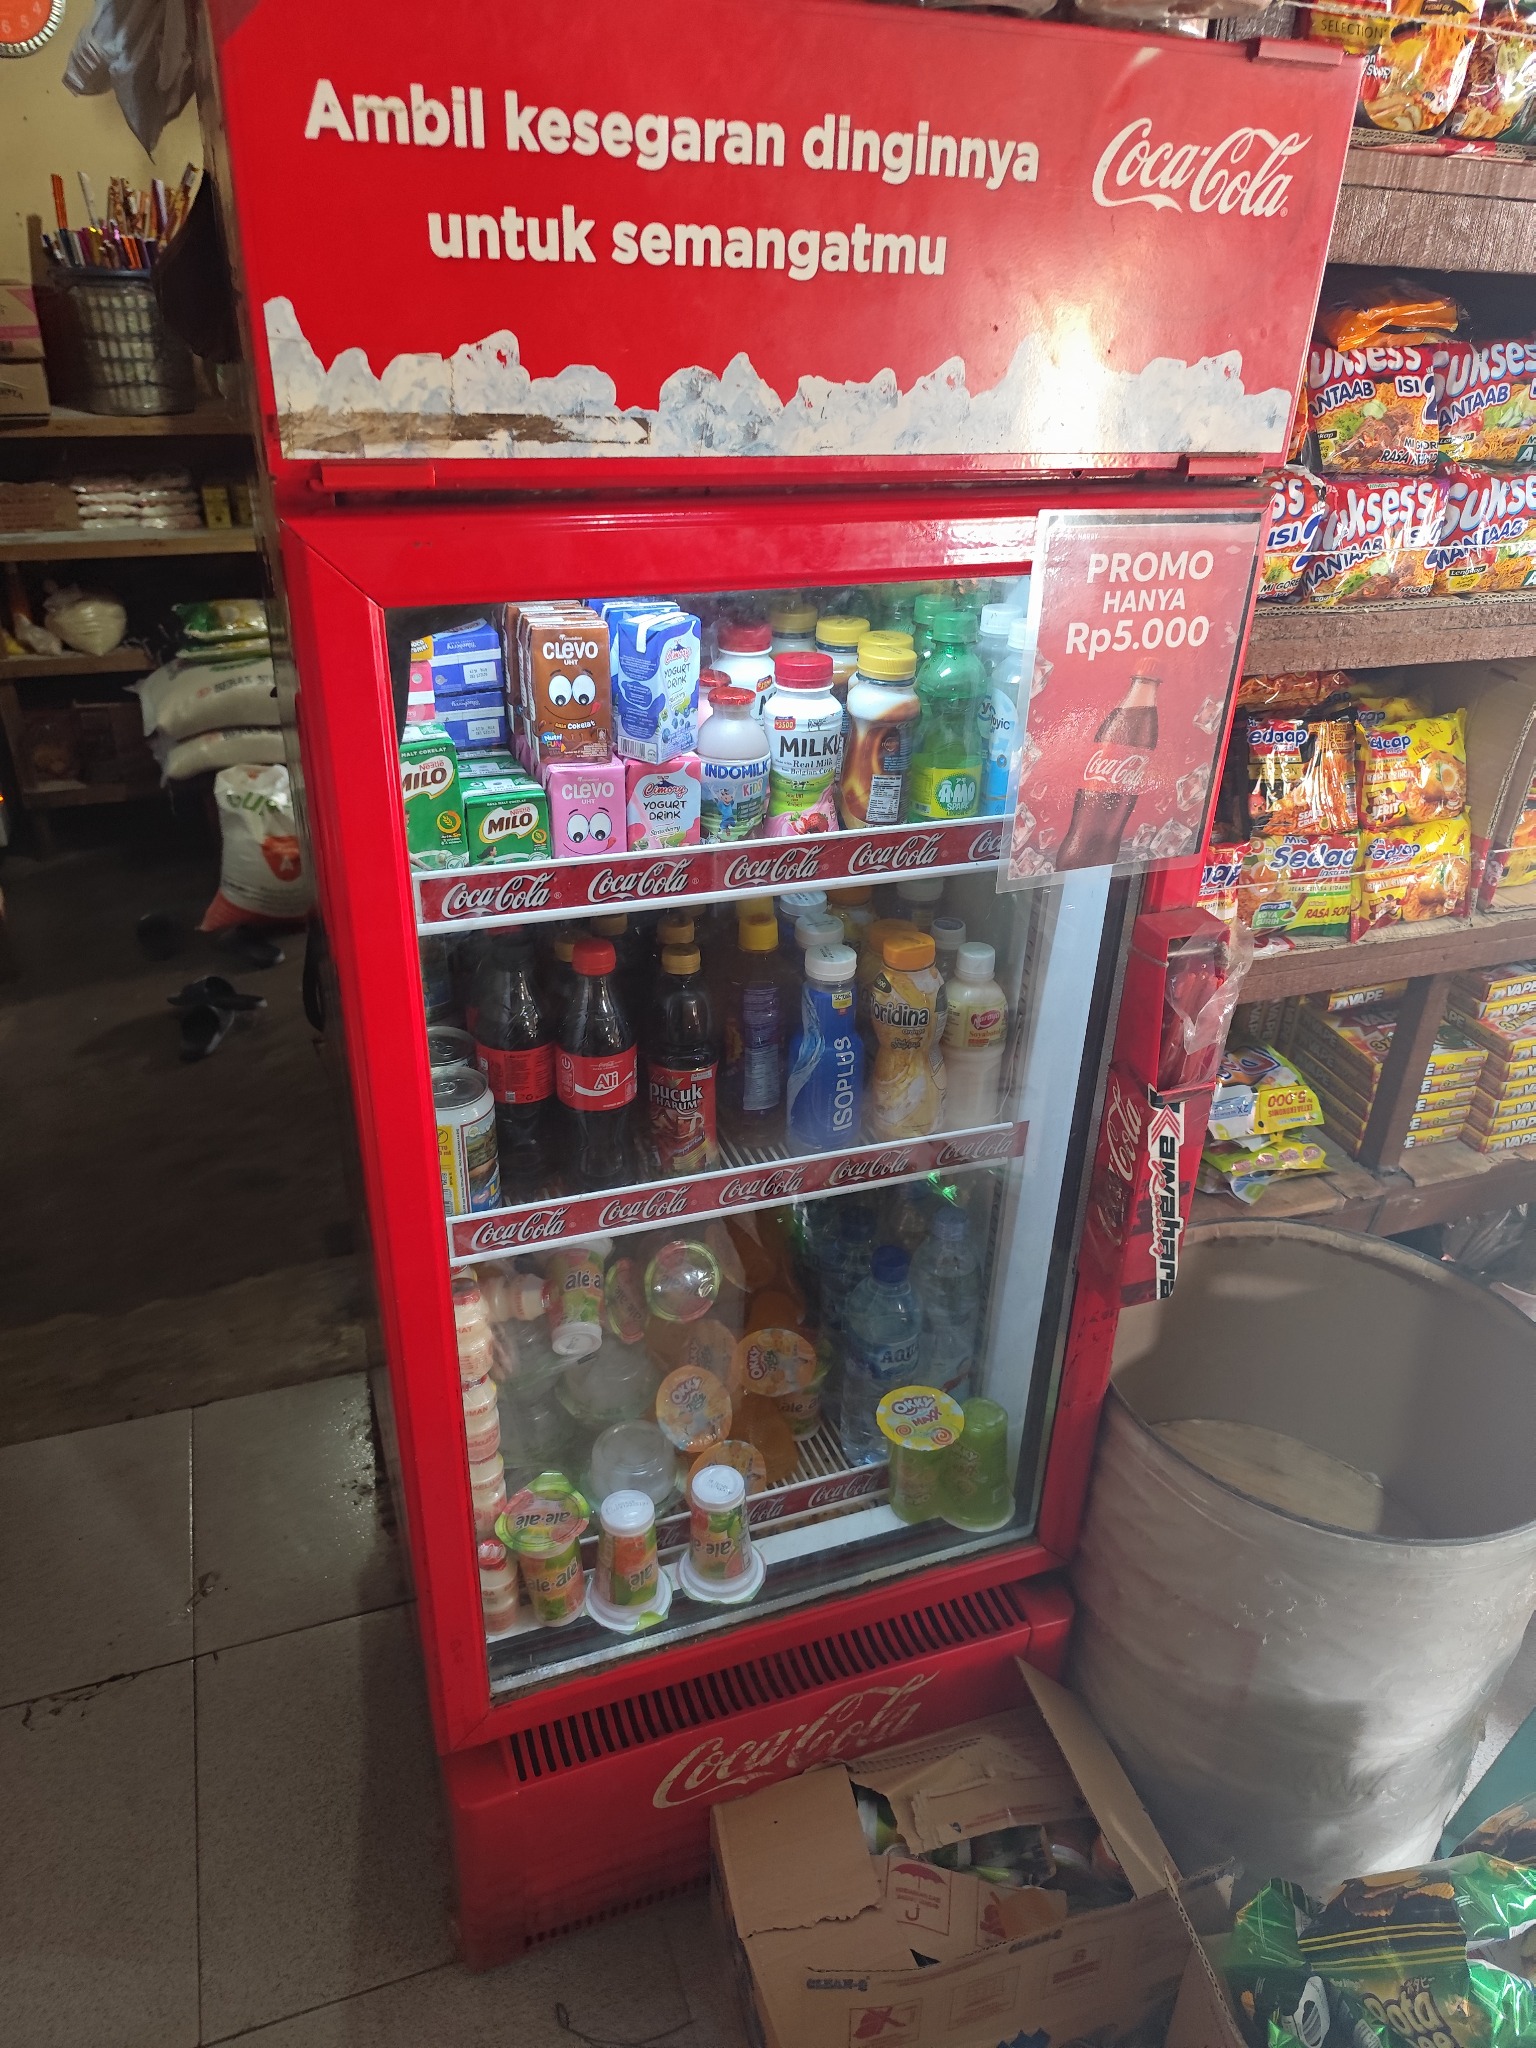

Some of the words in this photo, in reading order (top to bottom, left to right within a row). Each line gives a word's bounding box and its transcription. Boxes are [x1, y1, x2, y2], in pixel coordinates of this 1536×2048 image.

[1320, 18, 1384, 40] SELECTION
[305, 78, 485, 149] Ambil
[504, 90, 785, 170] kesegaran
[802, 113, 1039, 190] dinginnya
[1092, 117, 1312, 218] Coca-Cola
[427, 204, 597, 263] untuk
[611, 218, 947, 281] semangatmu
[1398, 378, 1420, 393] ISI
[1438, 385, 1509, 432] ANTAAB
[1267, 526, 1298, 547] ISI
[1086, 549, 1214, 584] PROMO
[1102, 587, 1186, 615] HANYA
[1065, 615, 1210, 662] Rp5.000
[1249, 727, 1308, 747] edaap
[401, 767, 448, 792] MILO
[704, 760, 769, 780] INDOMILK
[643, 783, 689, 799] Cimory
[643, 800, 688, 811] YOGURT
[487, 813, 533, 836] MILO
[723, 843, 826, 889] Coca-Cola
[848, 831, 947, 875] Coca-Cola
[1270, 842, 1358, 870] Sedaa
[442, 871, 556, 918] Coca-Cola
[588, 857, 686, 903] Coca-Cola
[1304, 908, 1329, 919] RASA
[833, 1036, 855, 1132] ISOPLUS
[1267, 1091, 1306, 1108] 5.000
[656, 1097, 697, 1111] HARUM
[936, 1128, 1017, 1167] Coca-Cola
[828, 1148, 914, 1187] Coca-Cola
[718, 1166, 810, 1205] Coca-Cola
[598, 1184, 693, 1228] Coca-Cola
[470, 1205, 571, 1250] Coca-Cola
[891, 1396, 935, 1416] OKKY
[912, 1406, 943, 1428] MAXX
[807, 1474, 878, 1506] Coca-Cola
[652, 1670, 941, 1809] Coca-Cola
